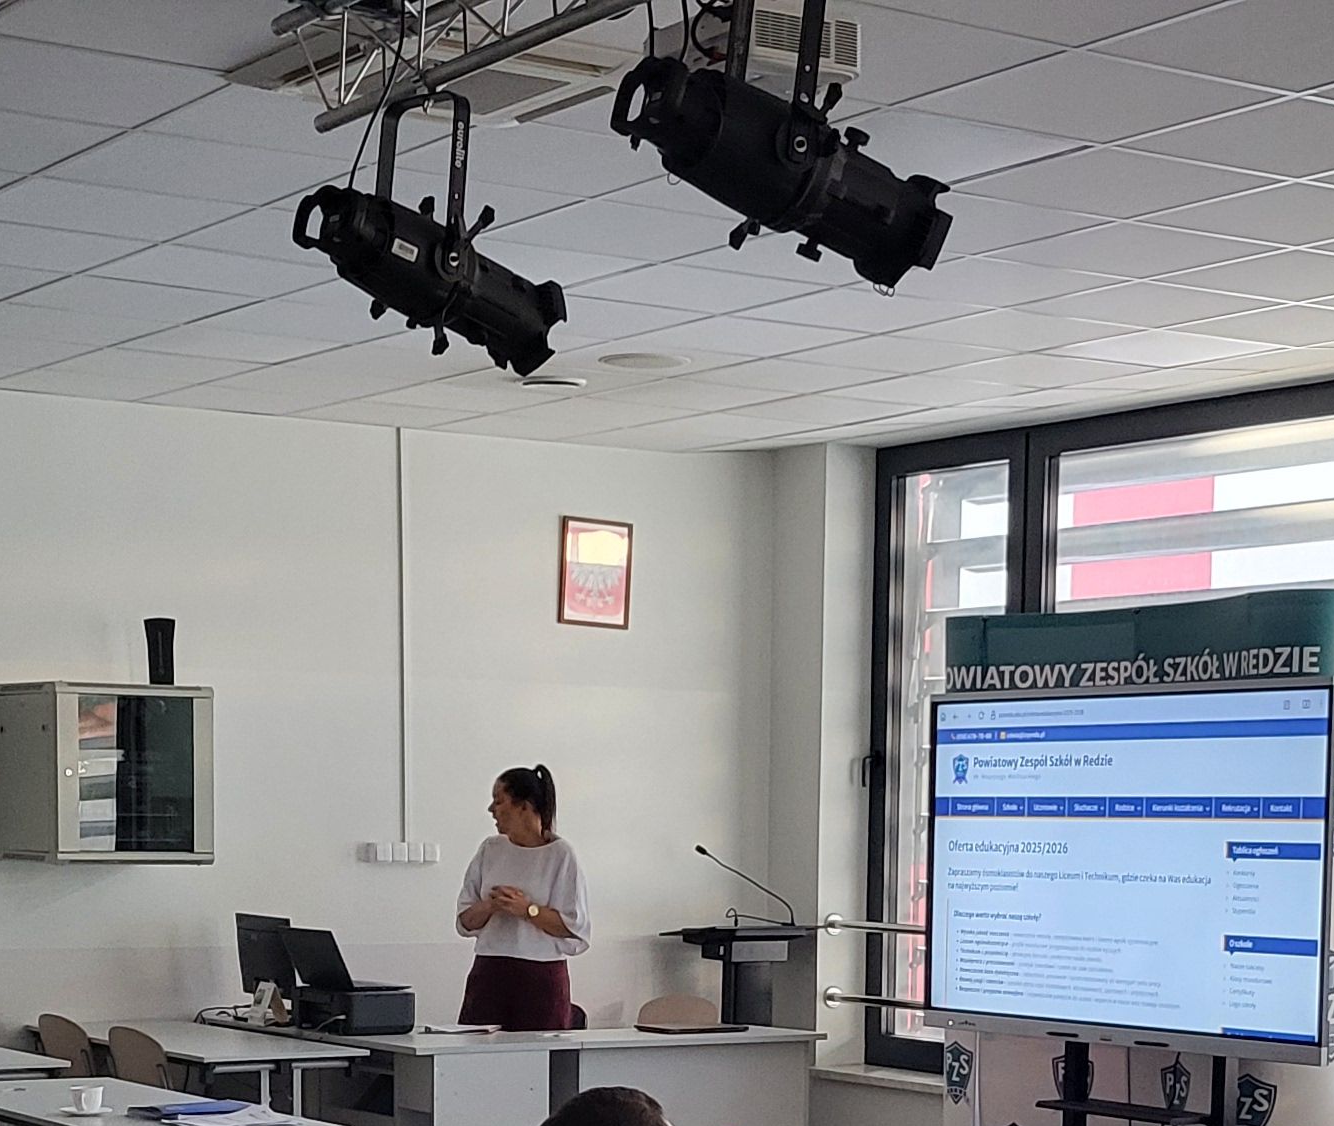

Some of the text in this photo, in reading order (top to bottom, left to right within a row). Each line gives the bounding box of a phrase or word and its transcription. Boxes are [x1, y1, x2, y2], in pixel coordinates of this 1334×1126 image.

[455, 121, 465, 169] eurolite
[1079, 653, 1159, 686] ZESPÓŁ
[1163, 648, 1220, 683] SZKÓŁ
[1223, 650, 1240, 679] W
[1240, 646, 1320, 676] REDZIE
[973, 752, 1113, 770] Powiatowy Zespół Szkół w Redzie
[948, 840, 1068, 855] Oferta edukacyjna 2025/2026
